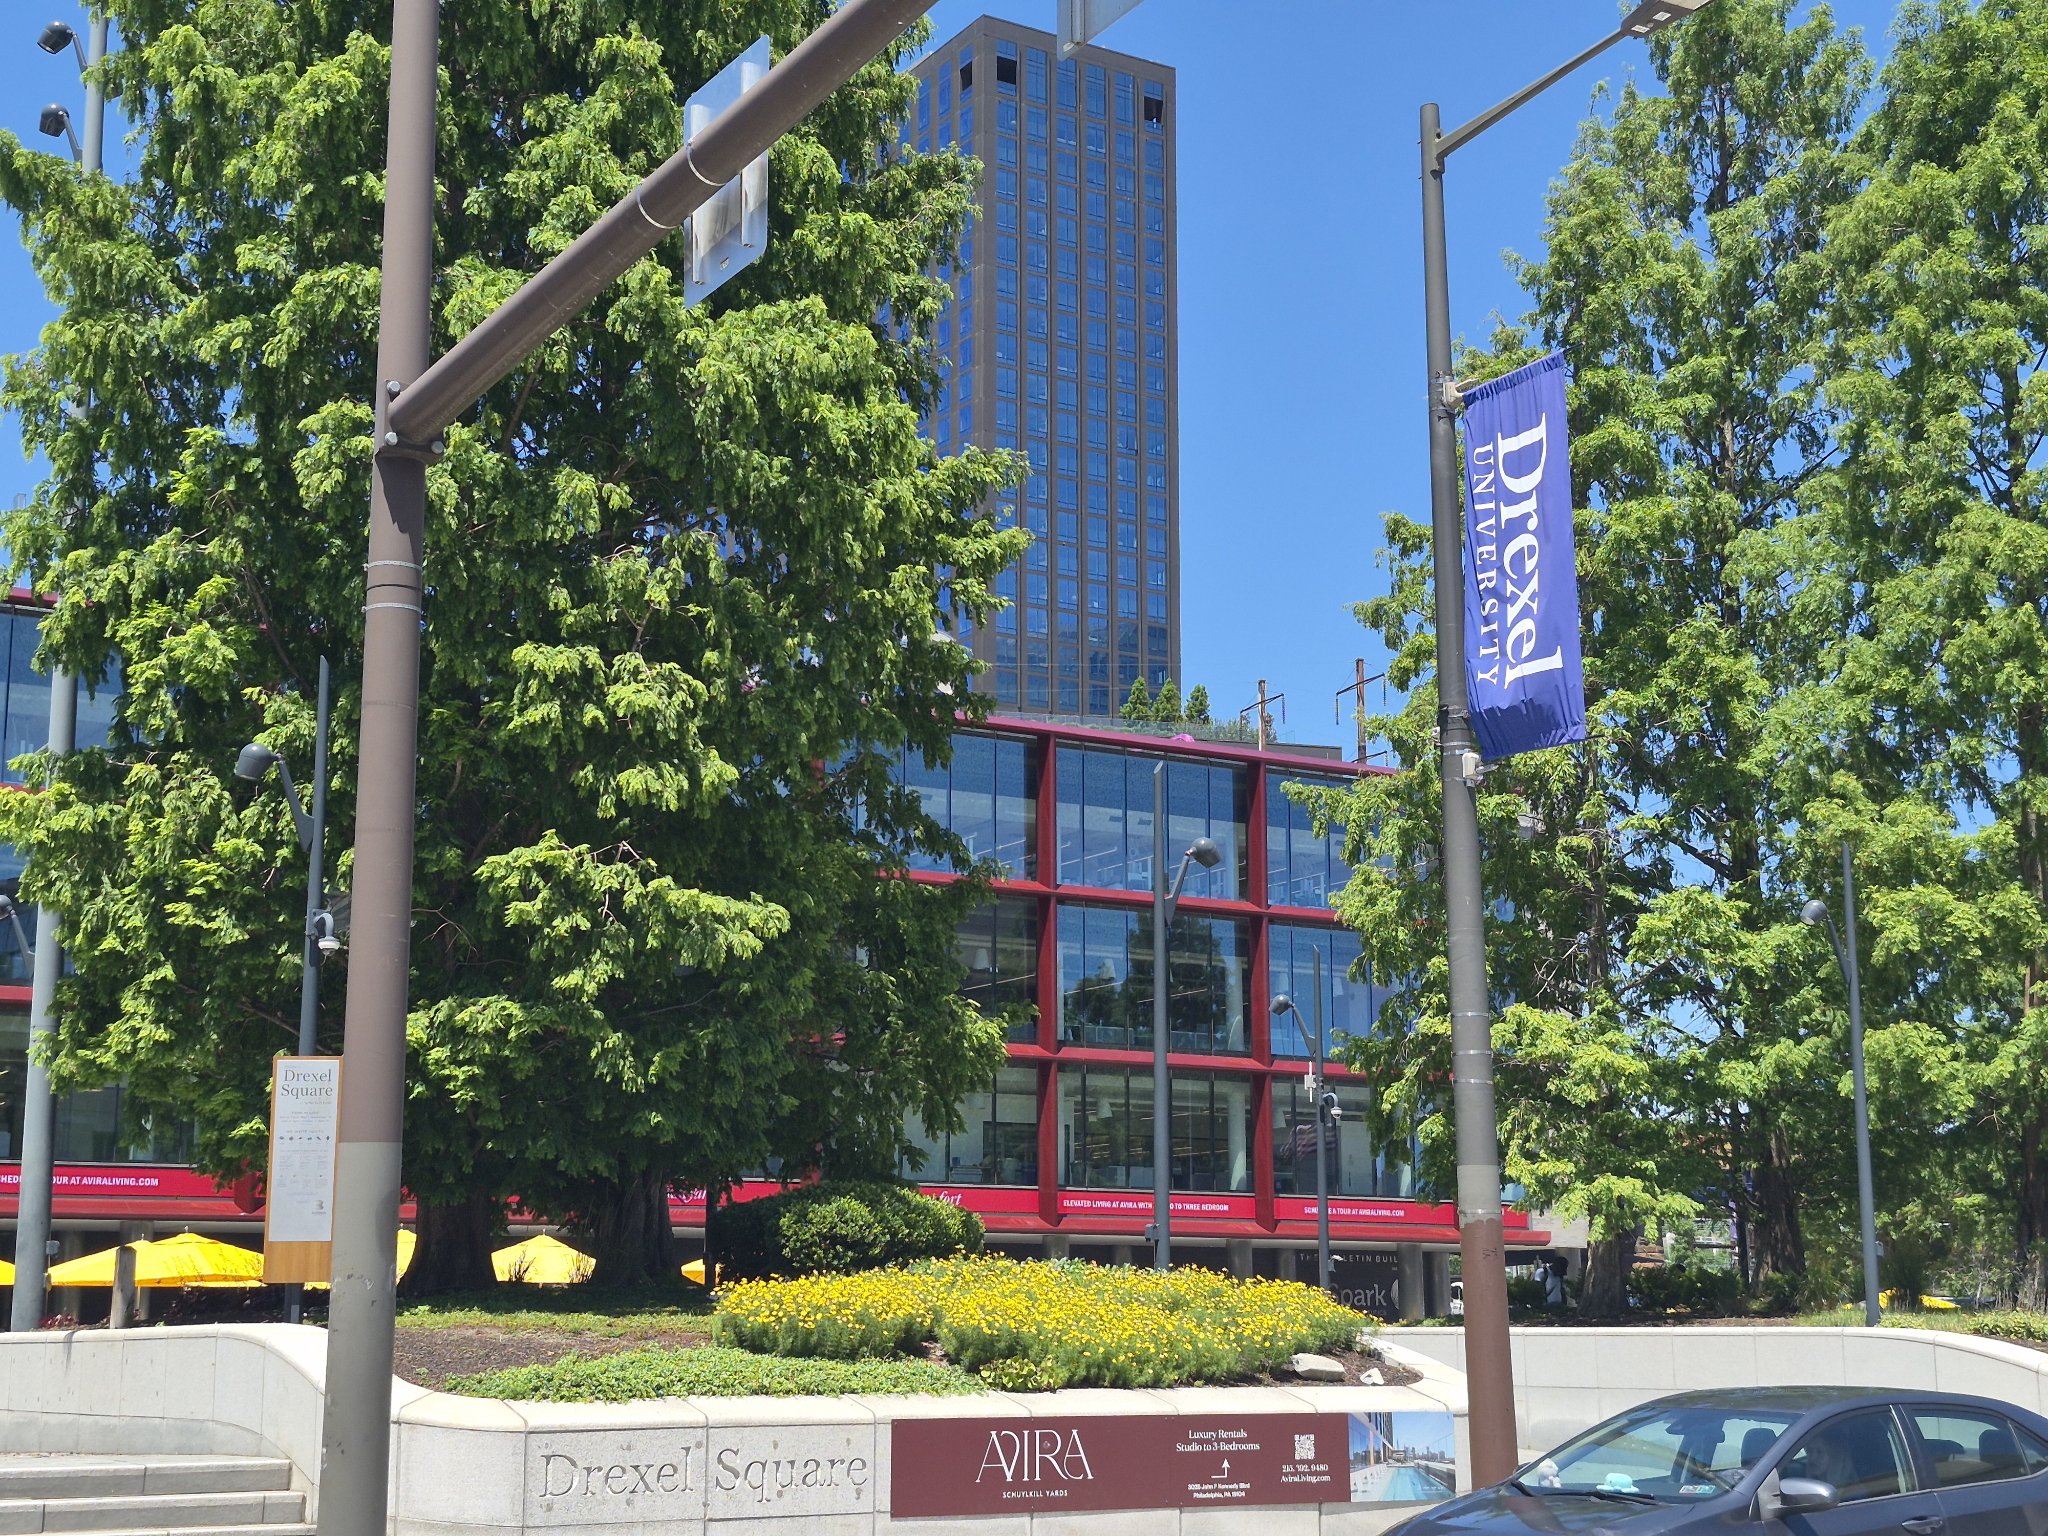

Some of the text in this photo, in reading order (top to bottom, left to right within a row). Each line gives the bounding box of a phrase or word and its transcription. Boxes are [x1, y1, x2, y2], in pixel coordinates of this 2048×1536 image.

[1496, 413, 1564, 690] Drexel
[1472, 441, 1499, 687] UNIVERSITY
[284, 1068, 332, 1082] Drexel
[281, 1084, 333, 1100] Square
[70, 1176, 82, 1186] AT
[82, 1176, 159, 1187] AVIRALIVING.COM
[1112, 1201, 1119, 1209] AT
[1188, 1428, 1248, 1441] Luxury Rentals
[1176, 1441, 1261, 1451] Studio to 3-Bedrooms
[975, 1429, 1094, 1483] AVIRA
[538, 1446, 868, 1503] Drexel Square
[1002, 1489, 1068, 1499] SCHUYLKILL YARDS
